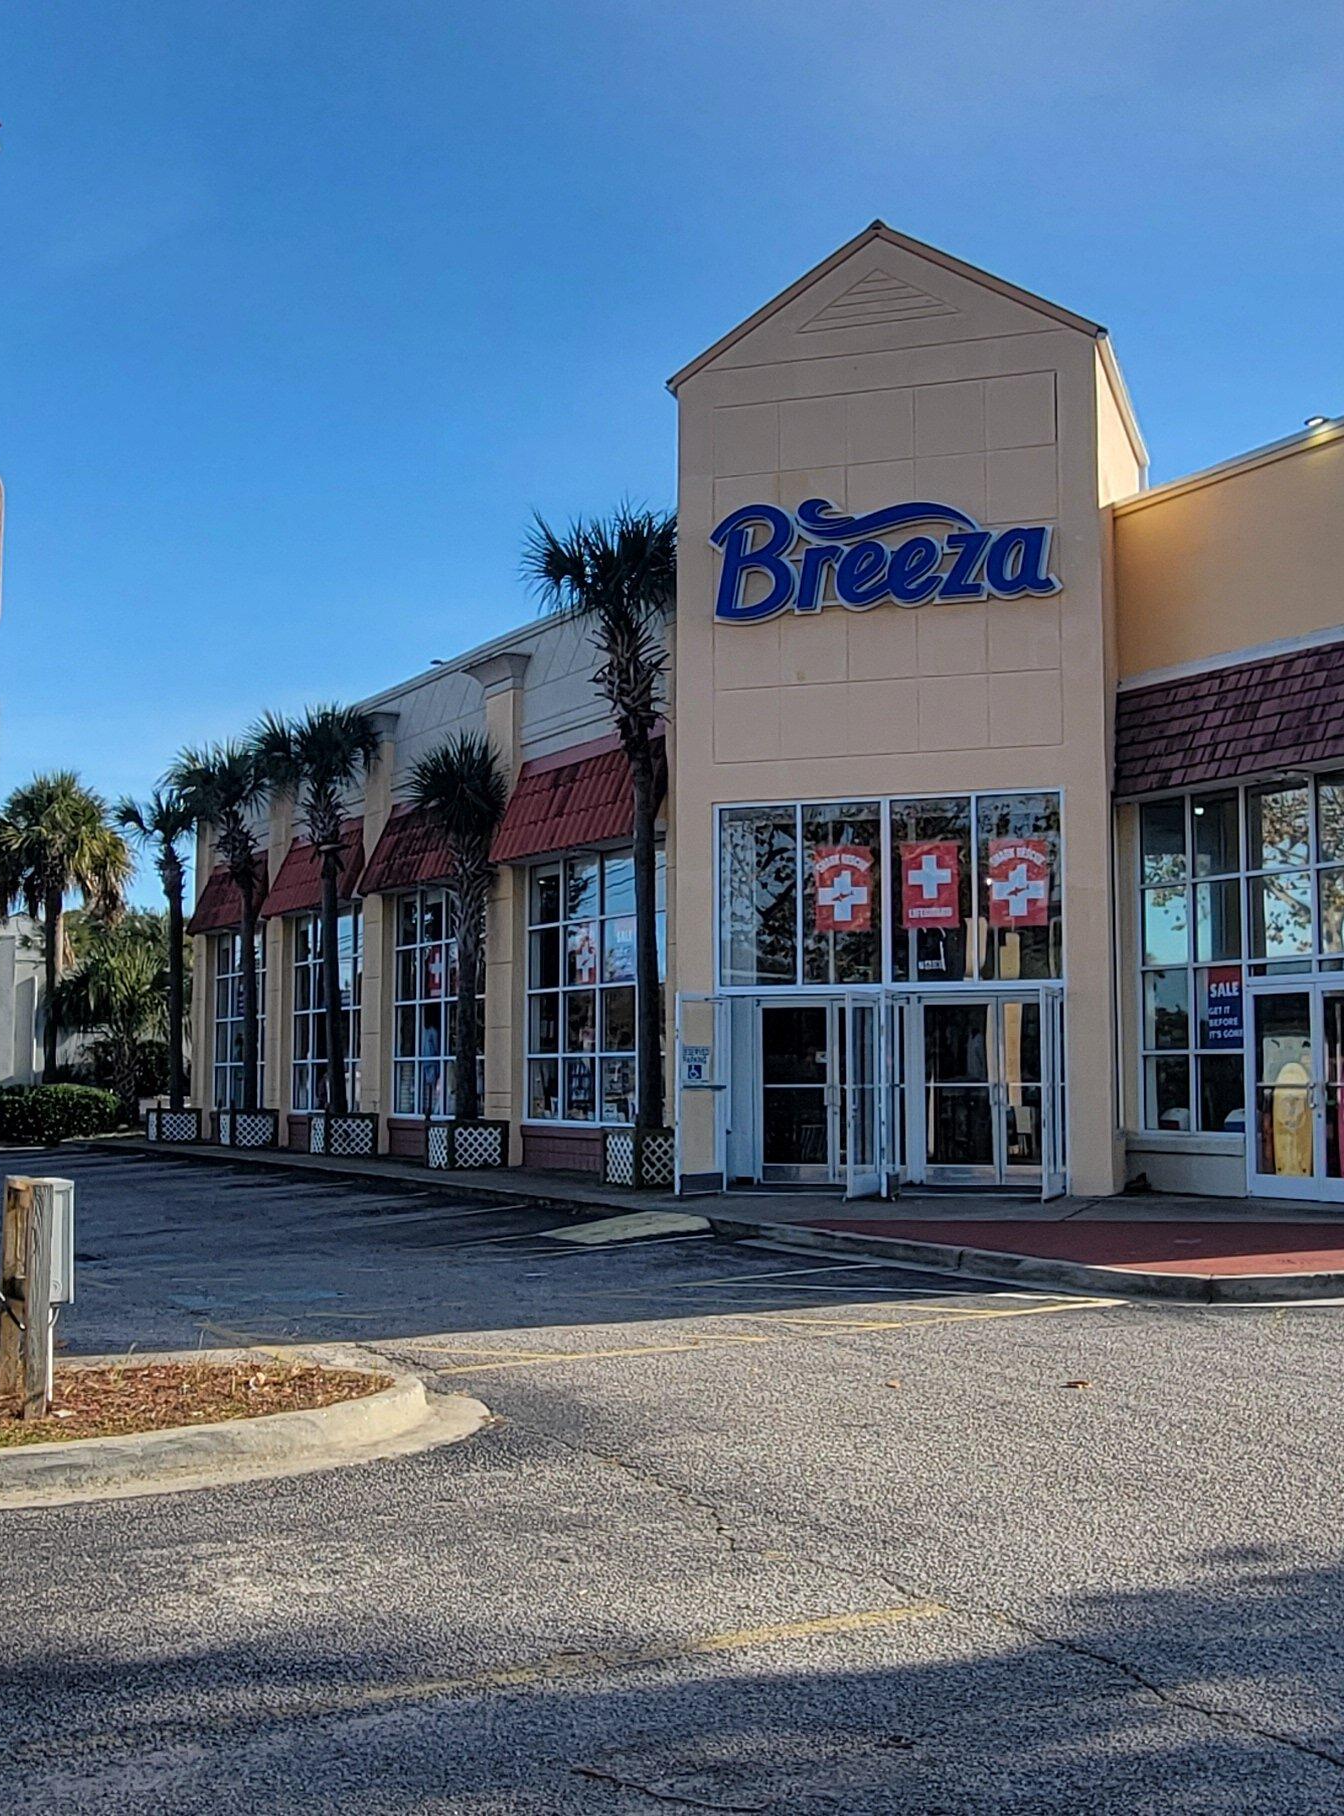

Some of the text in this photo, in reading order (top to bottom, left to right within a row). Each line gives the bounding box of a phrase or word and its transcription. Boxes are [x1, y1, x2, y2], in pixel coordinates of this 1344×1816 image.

[709, 498, 1062, 625] Breeza
[1210, 982, 1239, 998] SALE
[1209, 1006, 1230, 1015] GET IT
[1209, 1017, 1239, 1027] BEFORE
